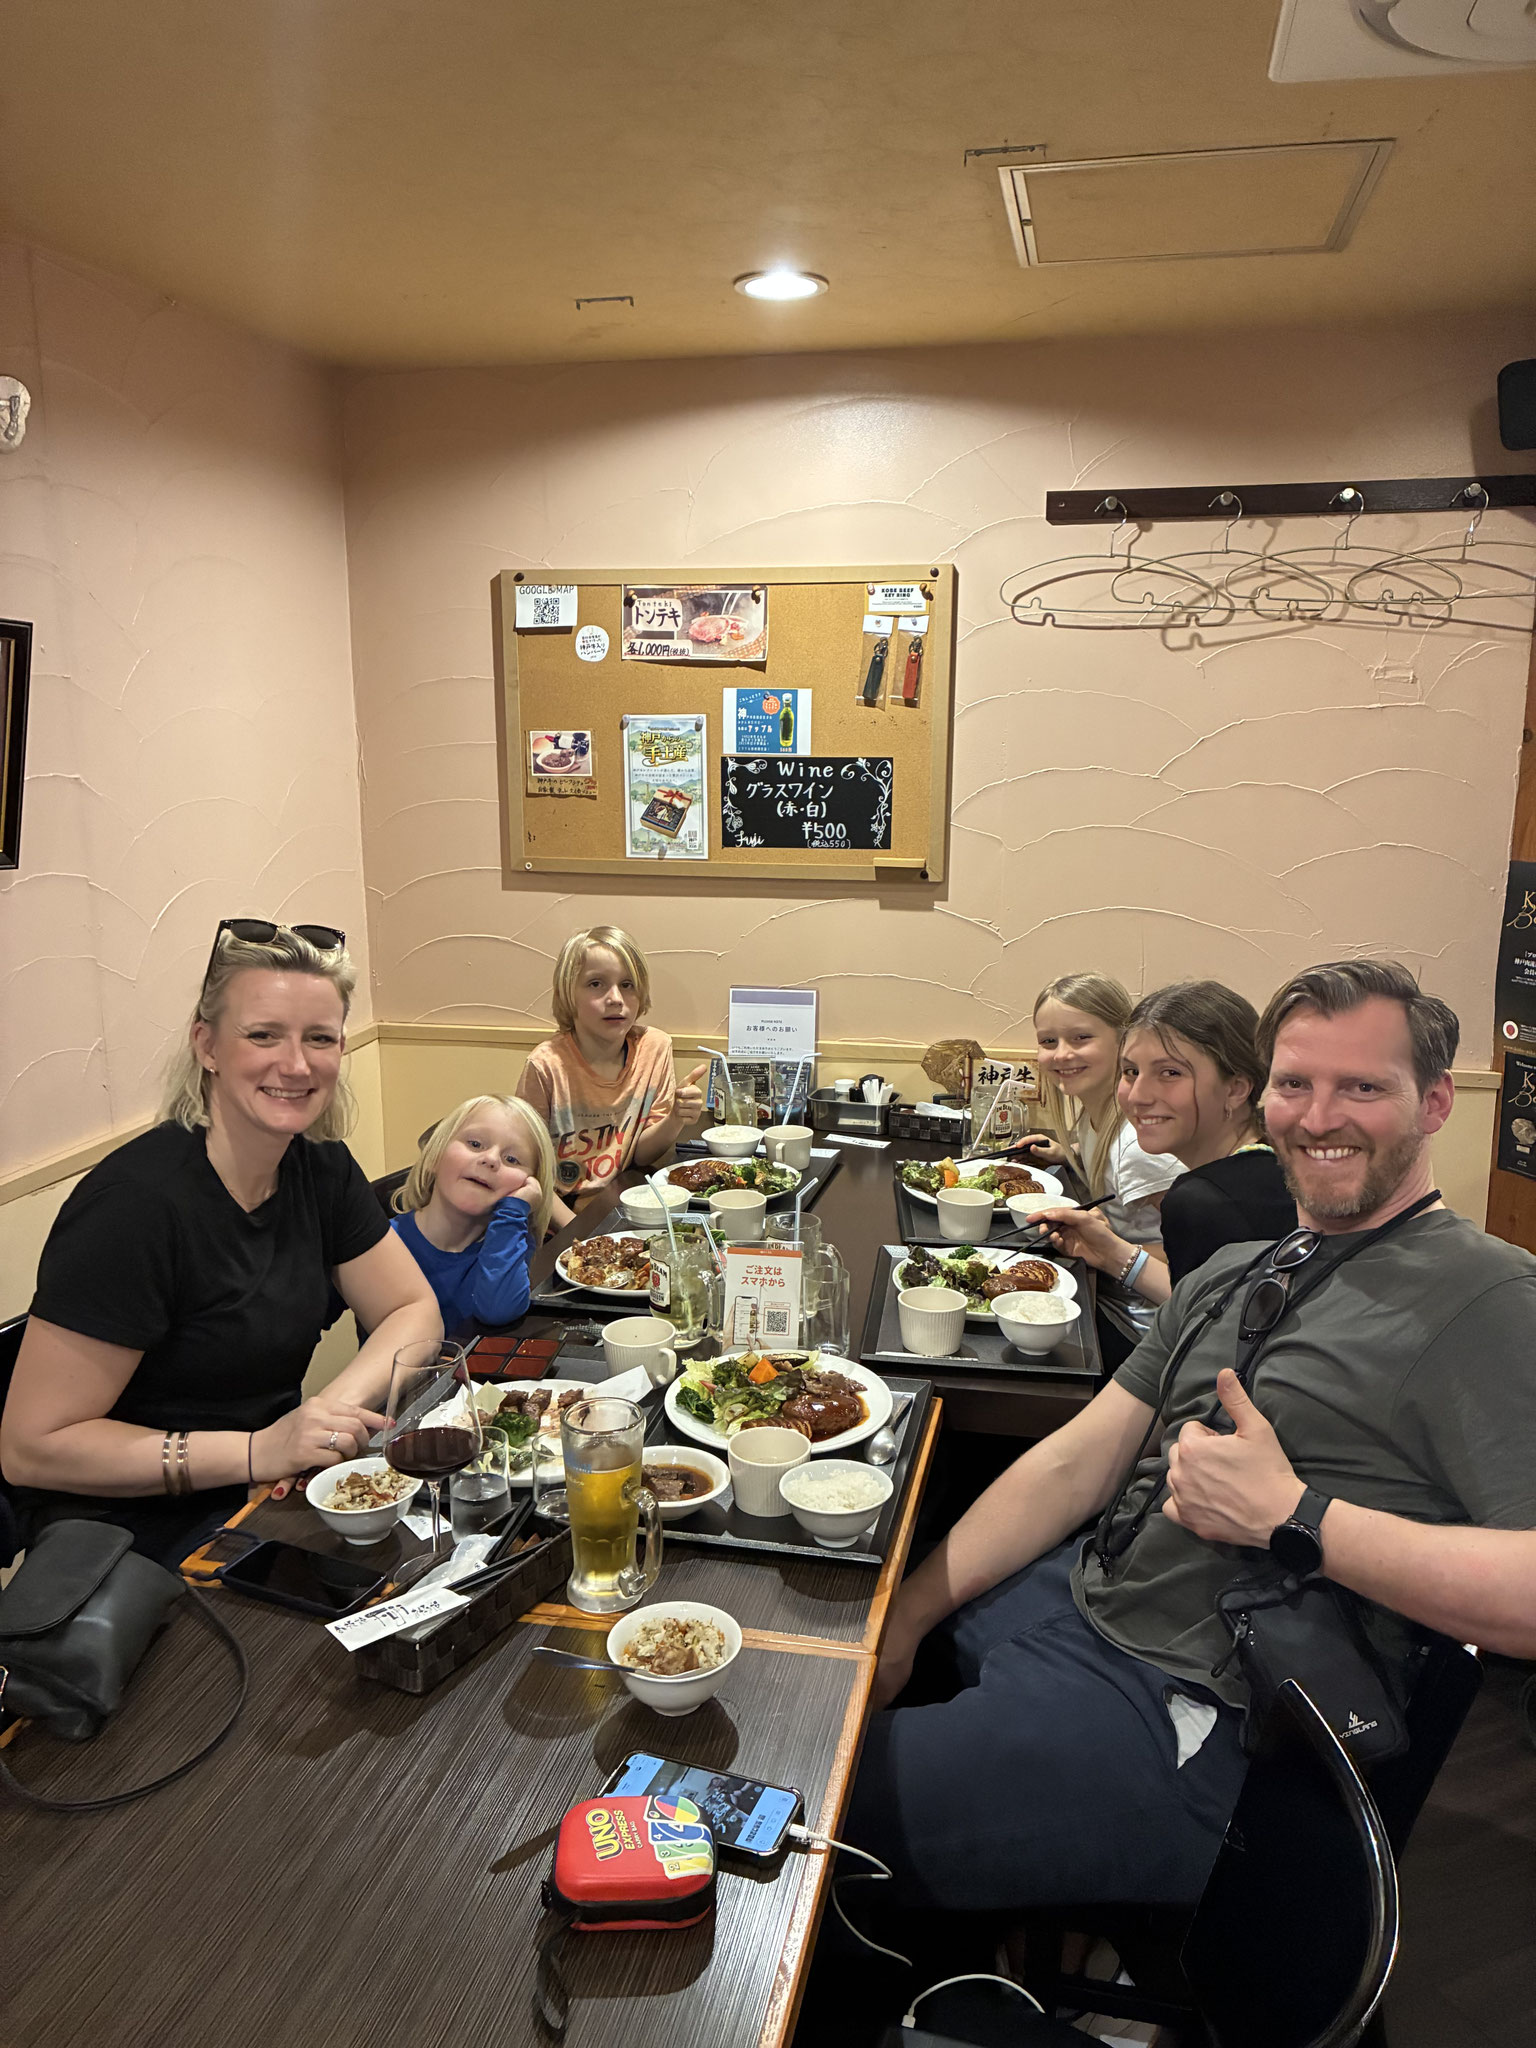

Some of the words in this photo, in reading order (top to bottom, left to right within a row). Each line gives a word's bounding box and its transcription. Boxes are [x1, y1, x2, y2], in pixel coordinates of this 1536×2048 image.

[556, 585, 575, 594] MAP
[635, 606, 681, 628] トンテキ
[776, 760, 834, 778] Wine
[746, 781, 834, 799] グラスワイン
[801, 821, 847, 840] ¥500
[746, 1025, 798, 1033] お客様へのお願い
[978, 1064, 1036, 1086] 神戸牛
[745, 1265, 783, 1276] ご注文は
[741, 1276, 786, 1288] スマホから
[585, 1808, 623, 1862] UNO
[613, 1809, 636, 1851] EXPRESS
[660, 1850, 671, 1858] 3
